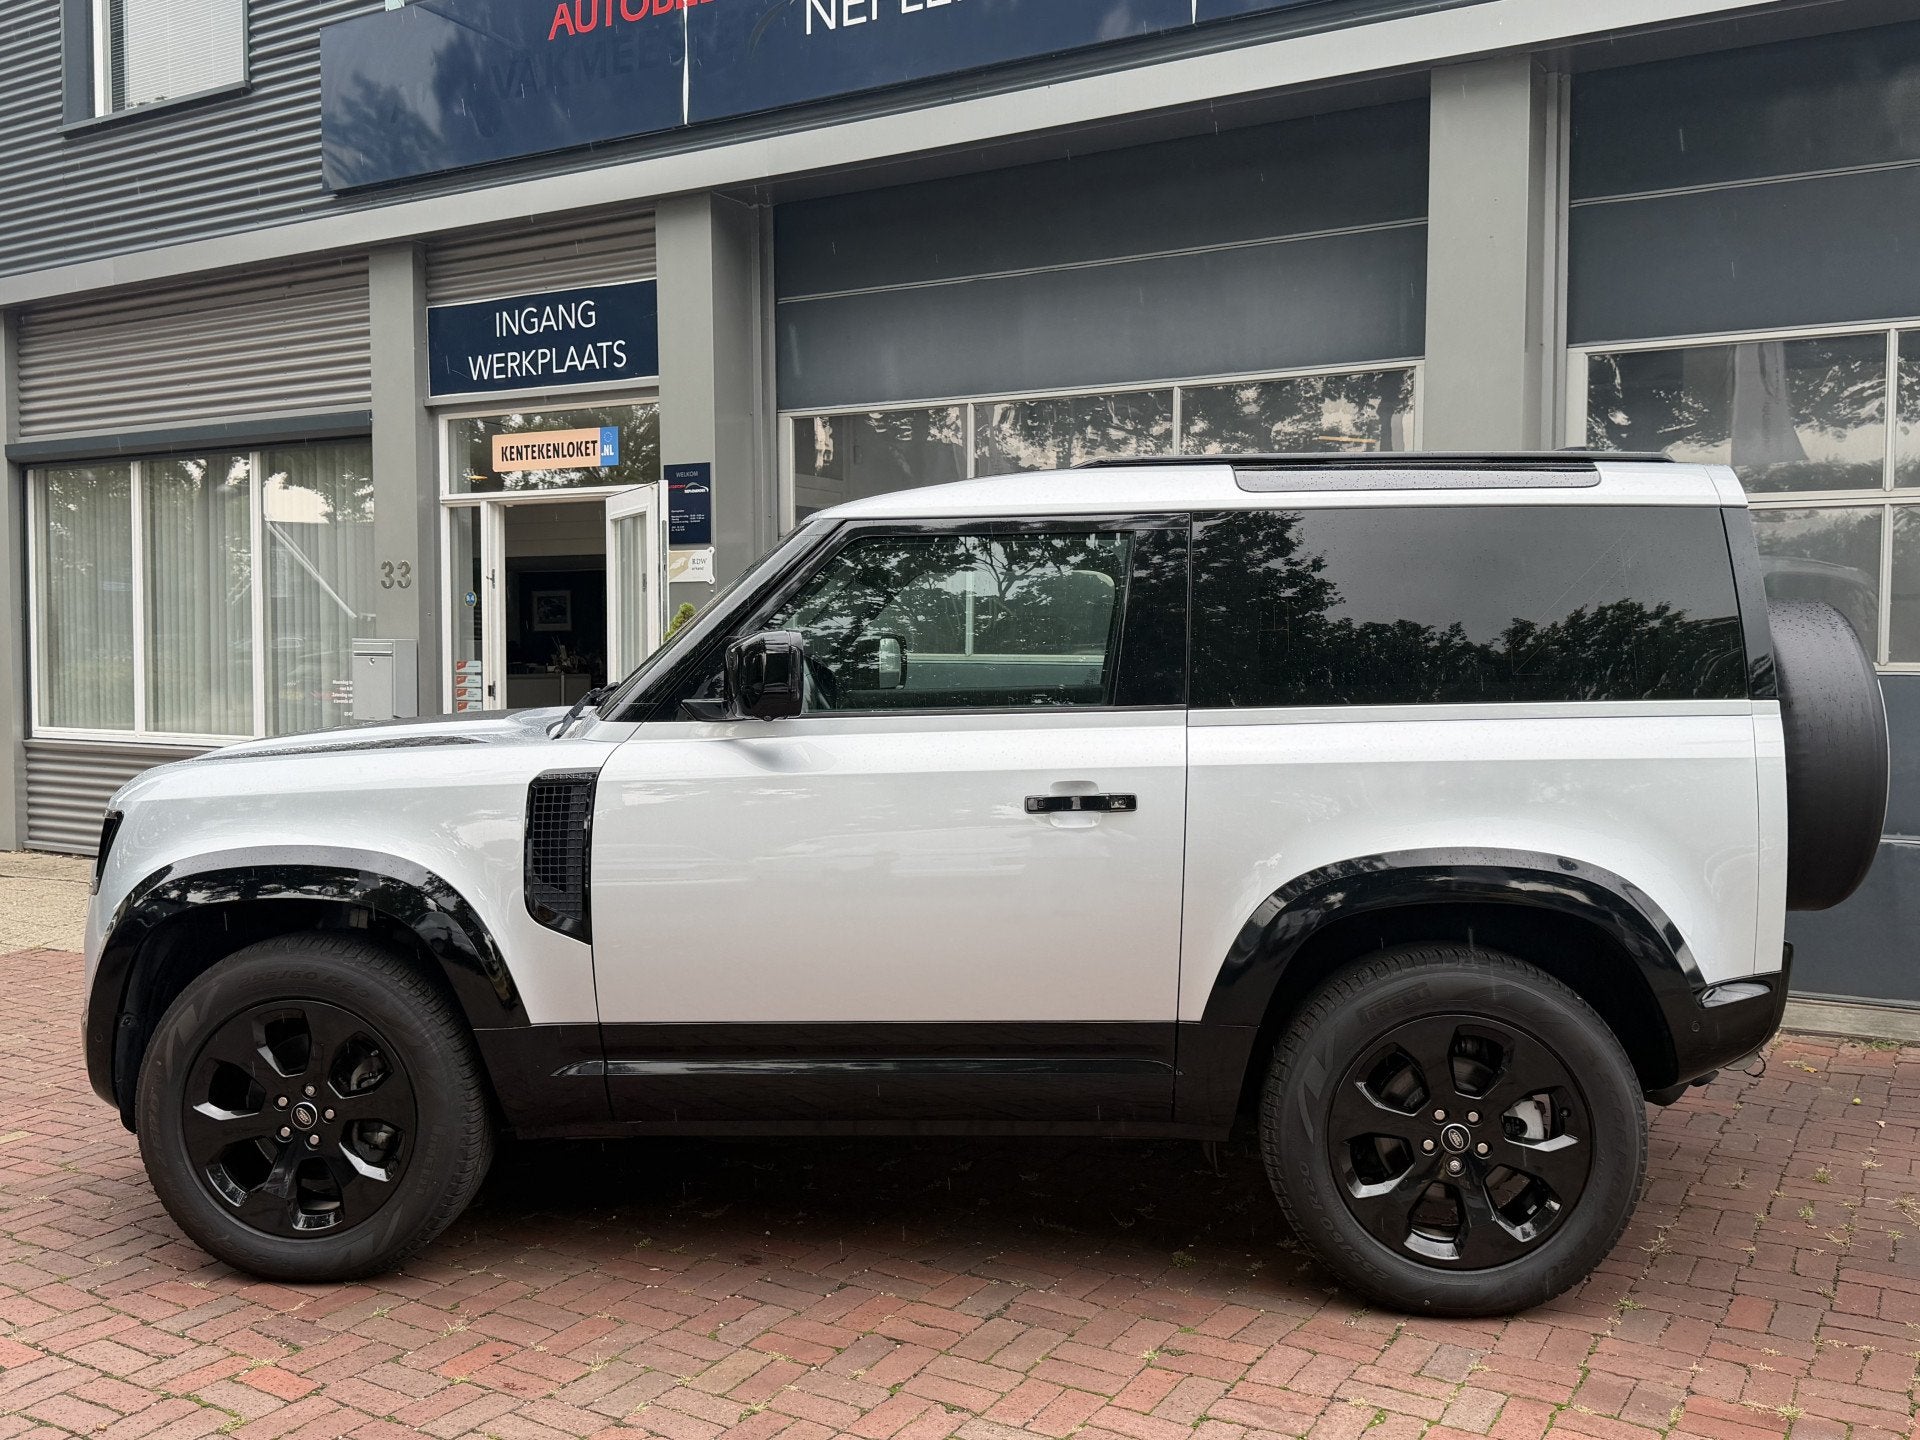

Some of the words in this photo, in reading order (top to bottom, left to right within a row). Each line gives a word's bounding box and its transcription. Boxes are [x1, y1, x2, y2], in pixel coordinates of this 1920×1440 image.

[495, 300, 596, 338] INGANG
[468, 340, 627, 381] WERKPLAATS
[380, 560, 412, 589] 33
